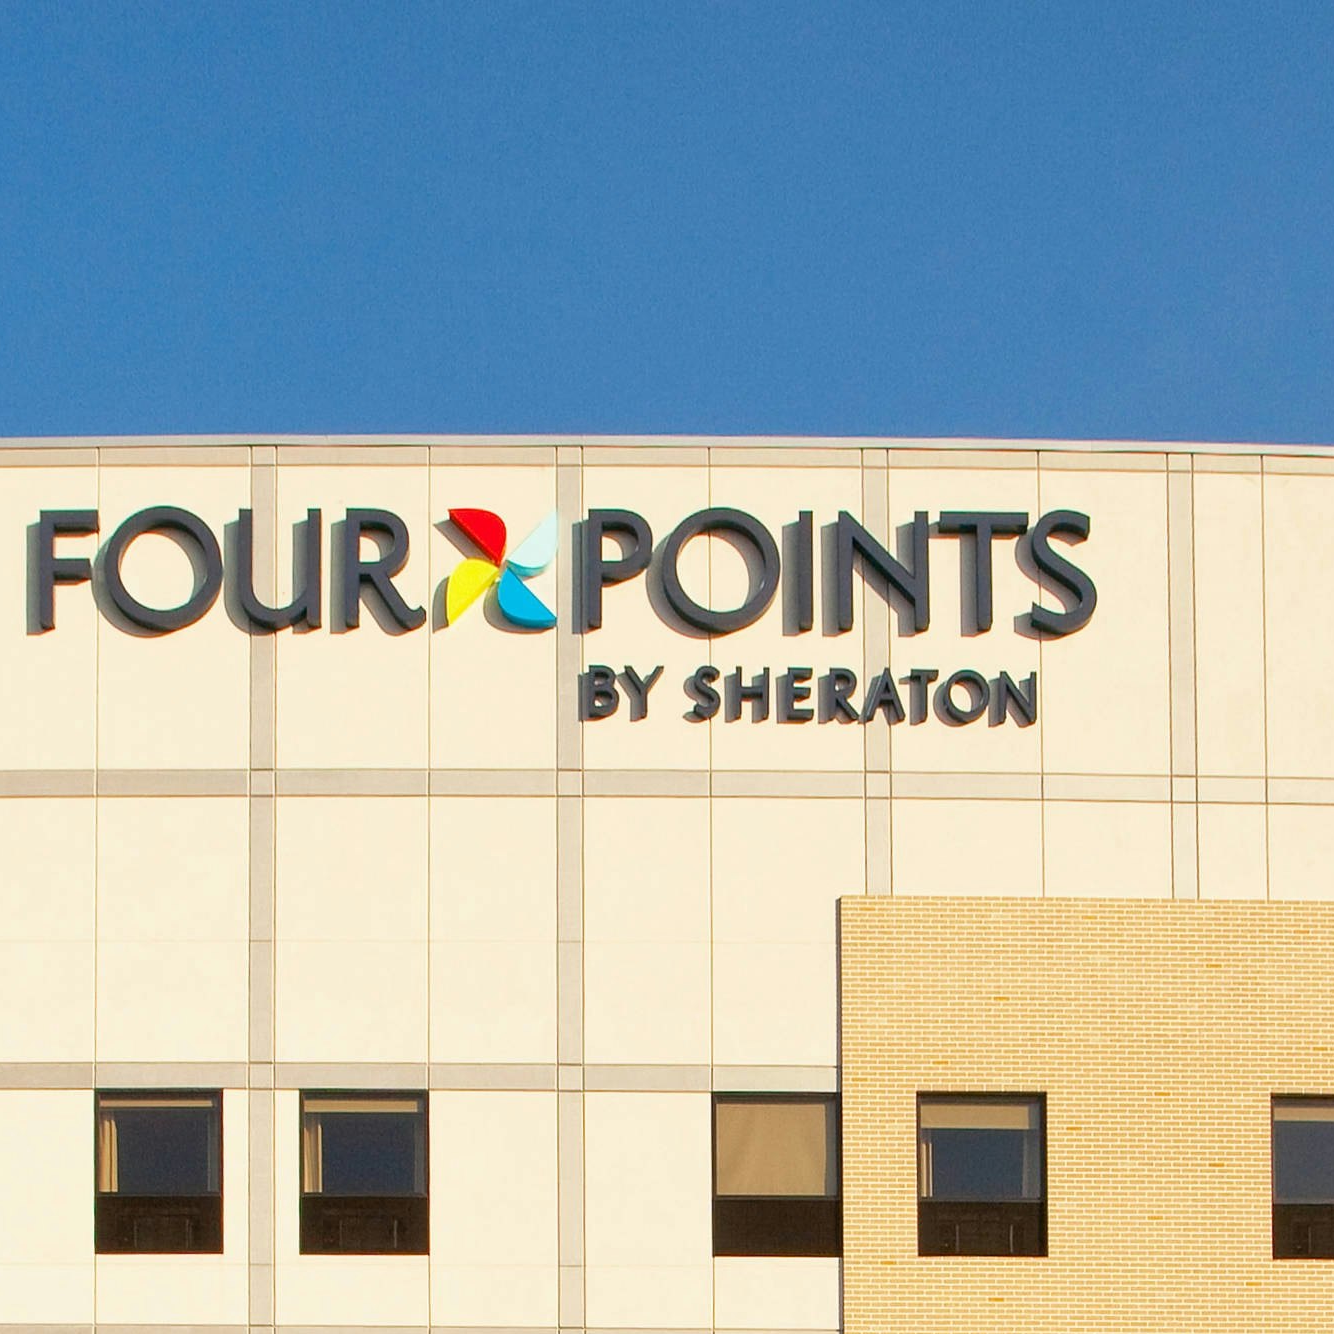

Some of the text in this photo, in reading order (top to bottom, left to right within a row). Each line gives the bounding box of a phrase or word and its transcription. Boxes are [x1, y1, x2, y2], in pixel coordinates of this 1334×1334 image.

[37, 505, 1098, 637] FOUR POINTS
[587, 665, 1038, 726] BY SHERATON
